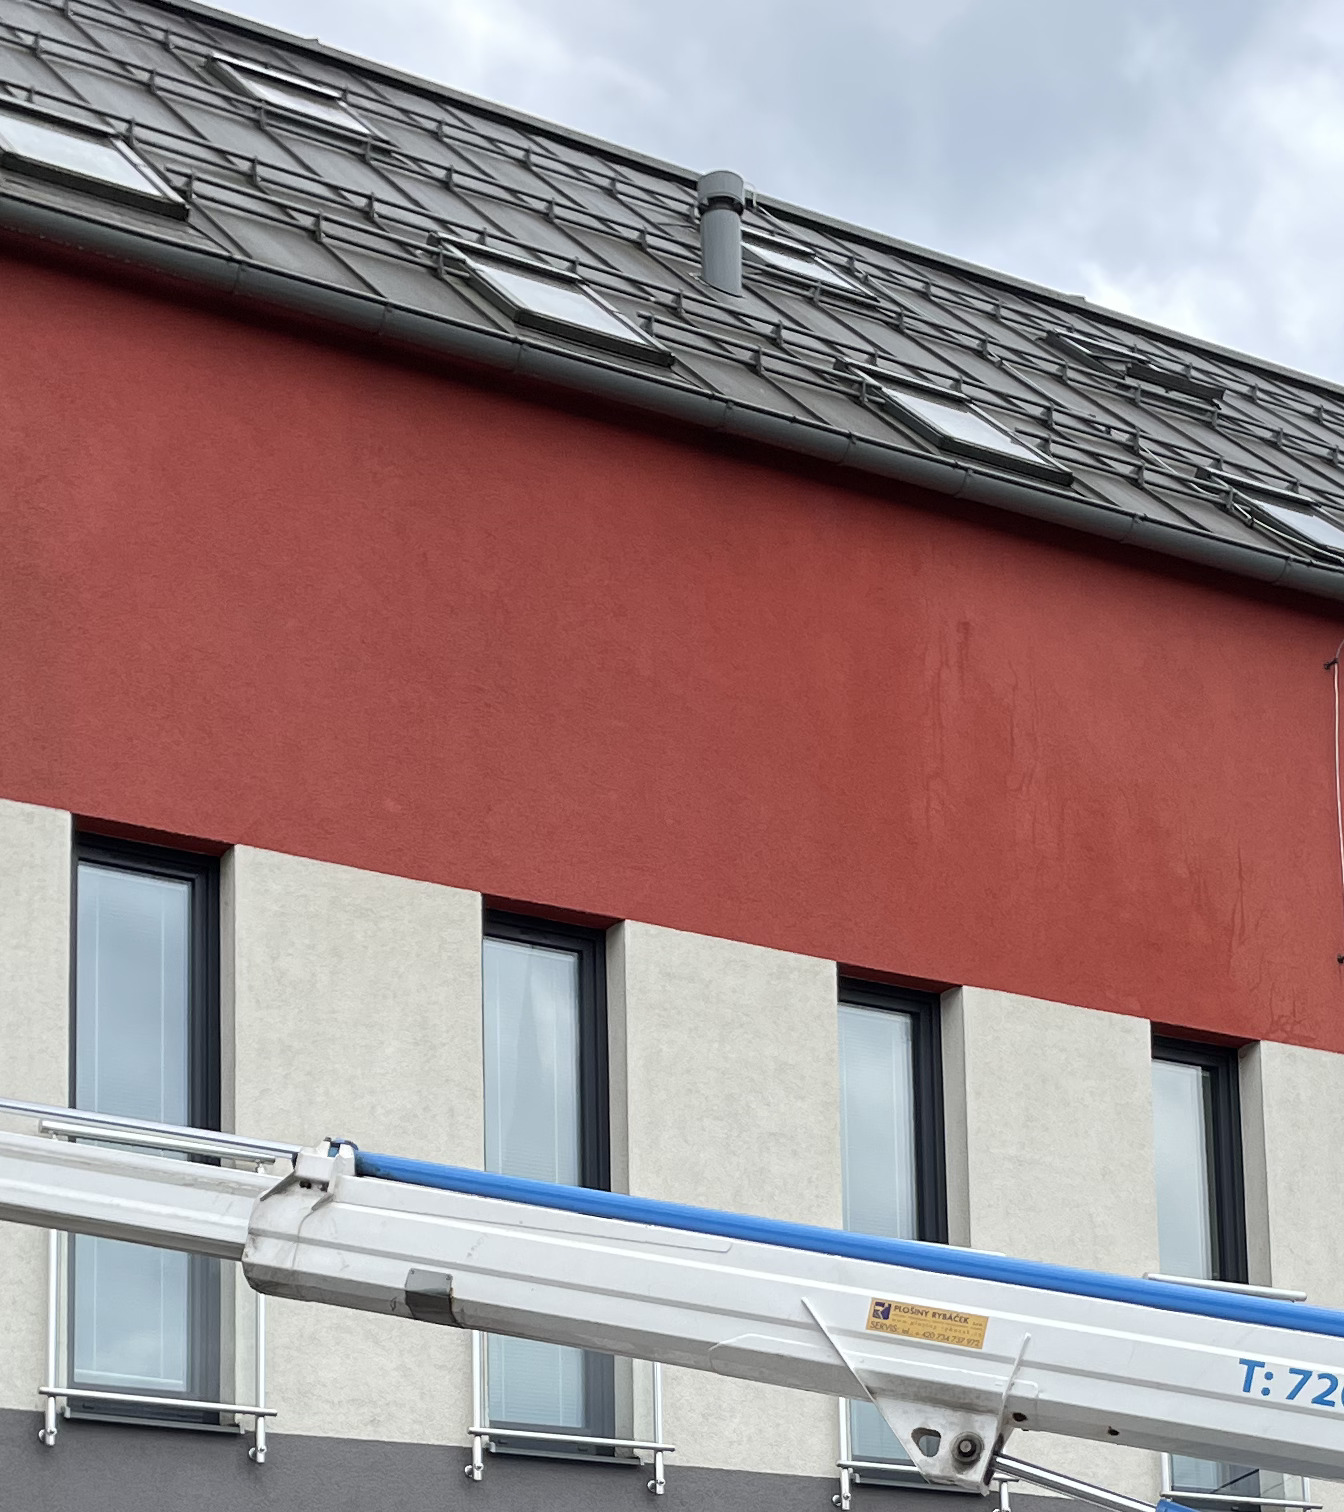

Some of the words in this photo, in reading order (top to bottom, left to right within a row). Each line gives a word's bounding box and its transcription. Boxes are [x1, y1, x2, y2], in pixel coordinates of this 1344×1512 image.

[893, 1304, 929, 1317] PLOŠINY
[932, 1311, 970, 1324] RYBÁČEK
[1239, 1358, 1274, 1396] T:
